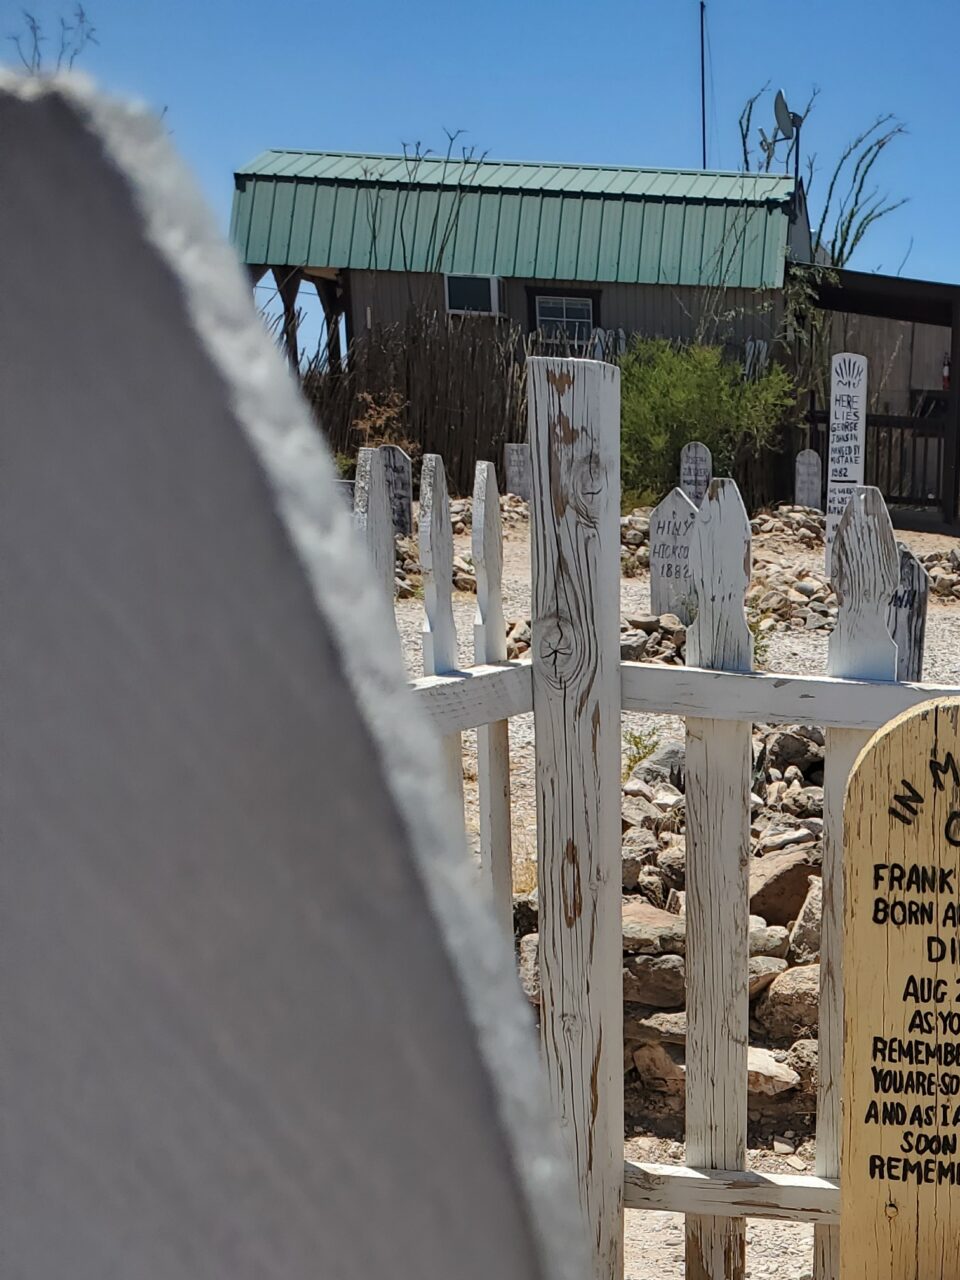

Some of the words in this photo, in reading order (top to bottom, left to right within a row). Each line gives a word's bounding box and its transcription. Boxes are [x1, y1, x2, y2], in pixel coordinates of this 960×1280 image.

[835, 394, 860, 410] HERE
[835, 411, 860, 421] LIES
[888, 779, 925, 825] IN
[873, 863, 954, 895] FRANK
[872, 897, 934, 926] BORN
[902, 974, 948, 1004] AUG
[864, 1100, 907, 1126] AND
[909, 1104, 936, 1128] AS
[941, 1104, 951, 1126] I
[900, 1130, 957, 1156] SOON
